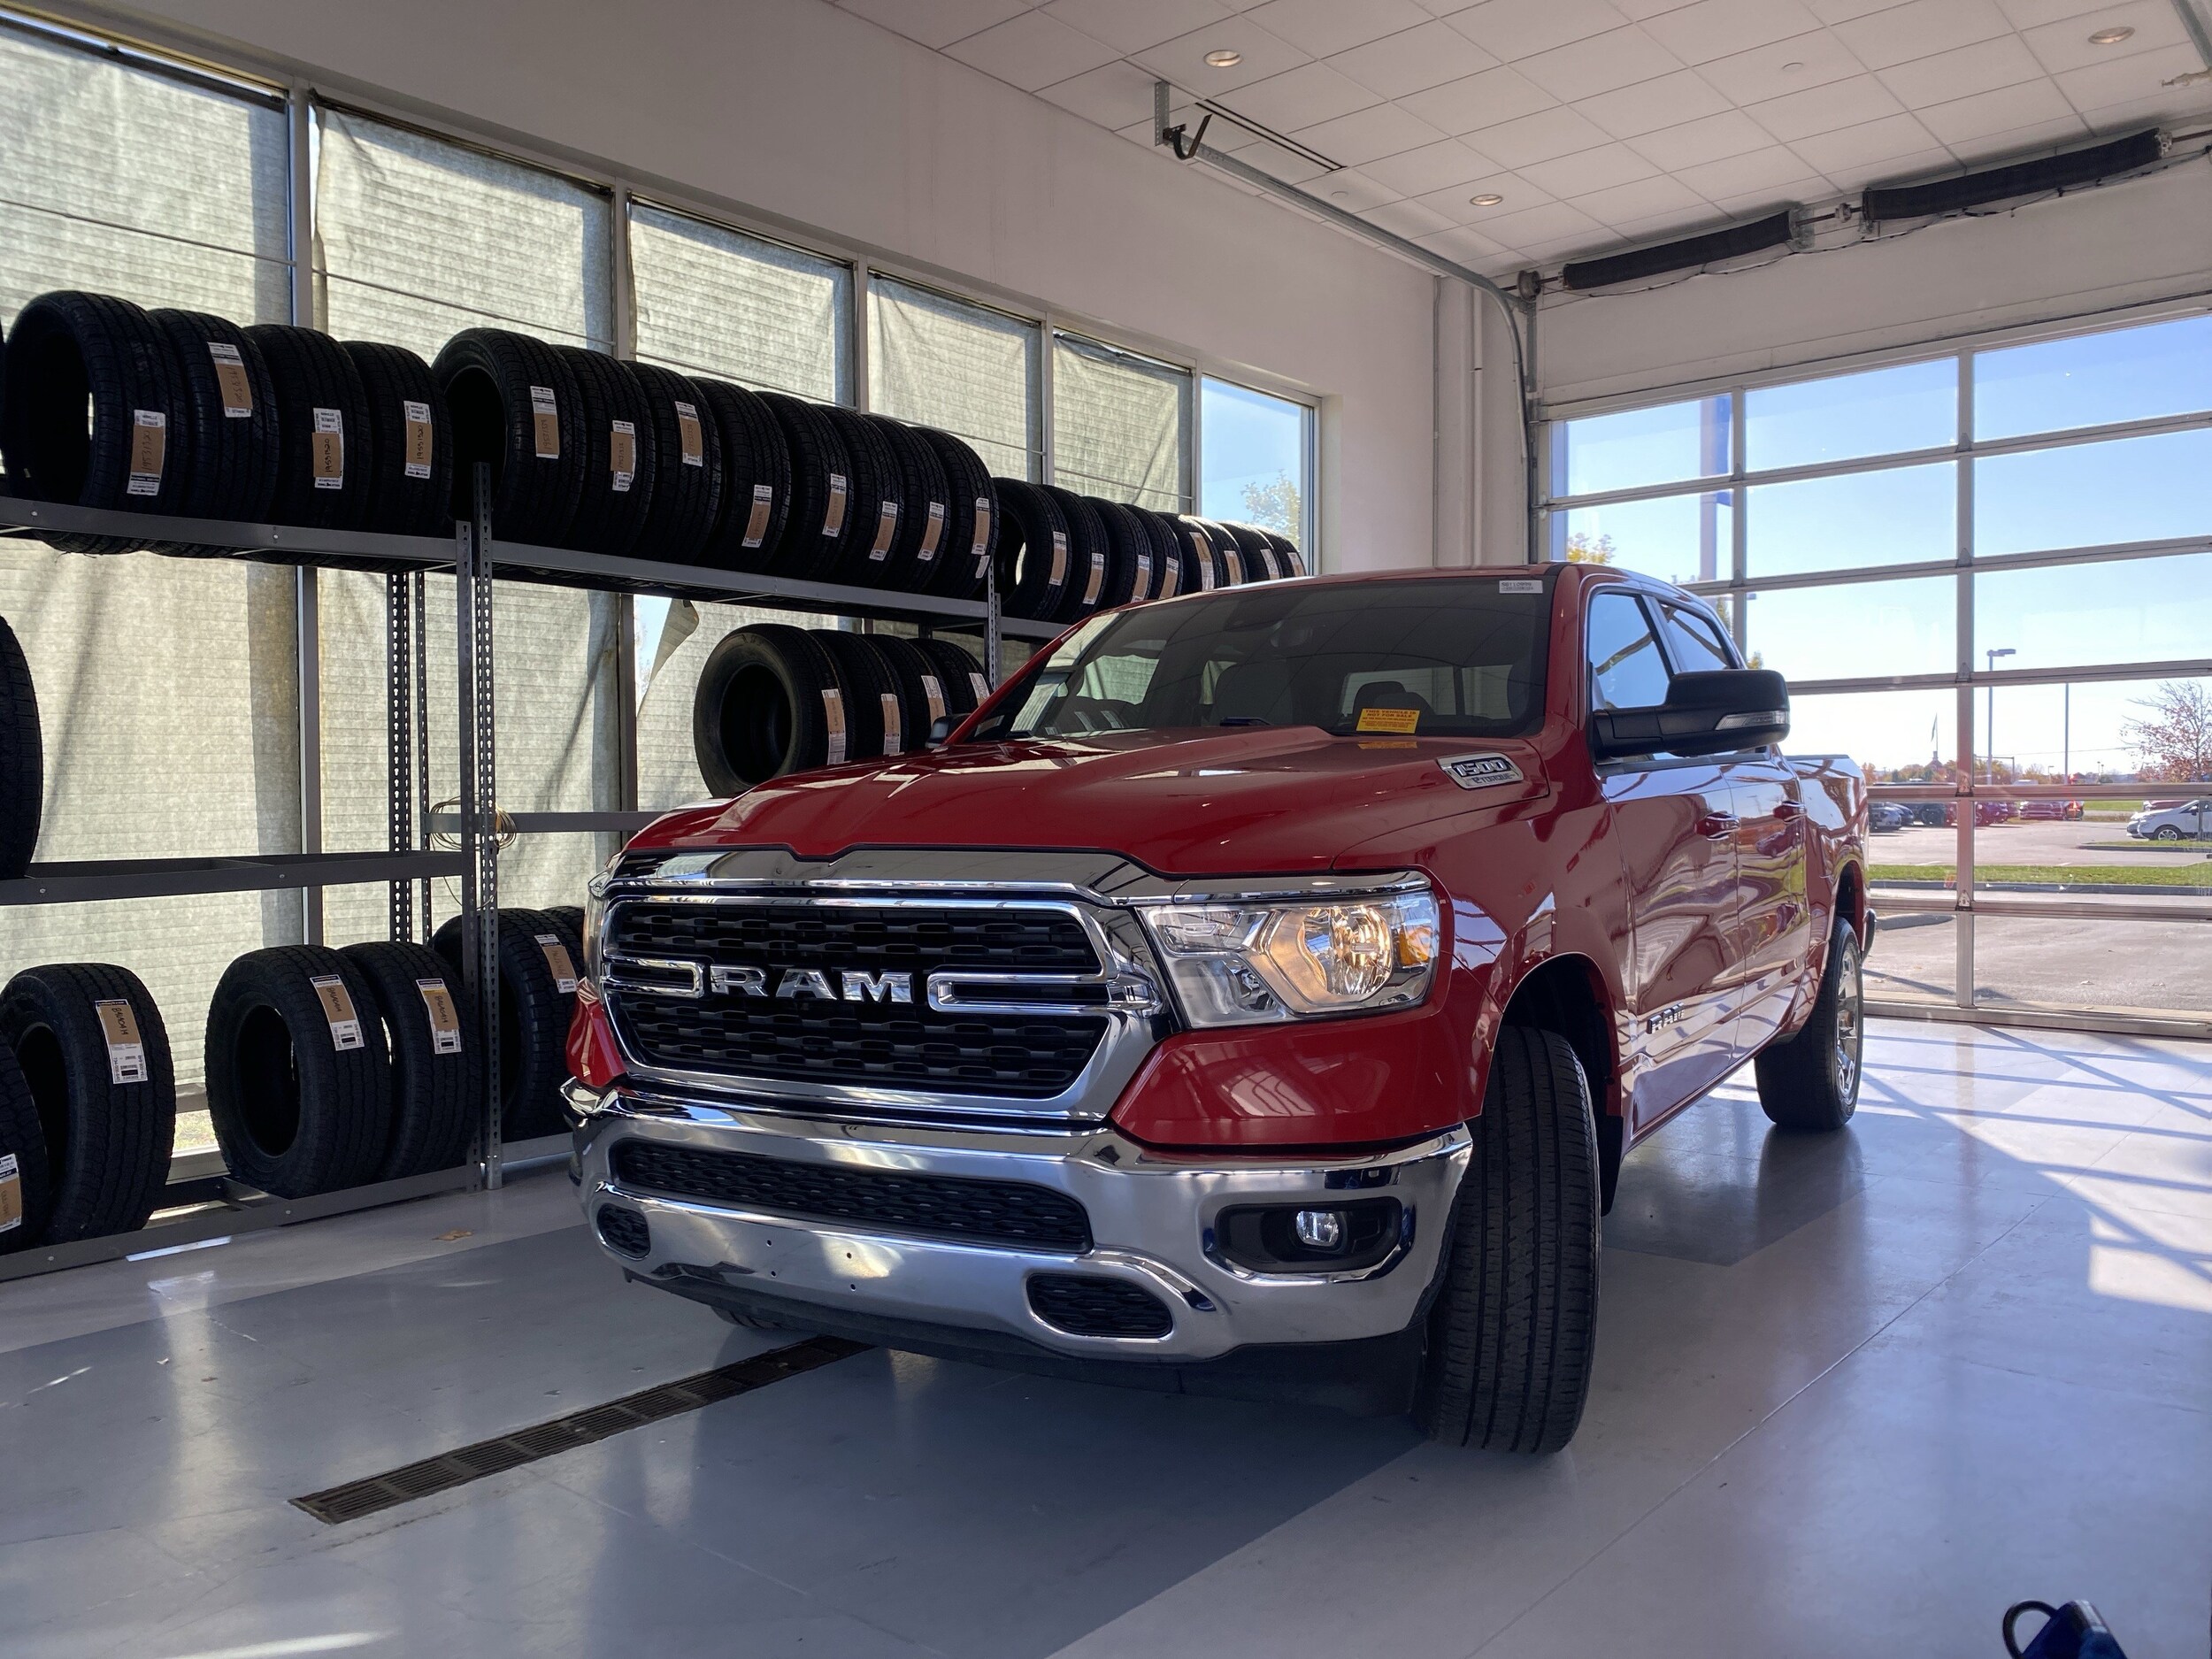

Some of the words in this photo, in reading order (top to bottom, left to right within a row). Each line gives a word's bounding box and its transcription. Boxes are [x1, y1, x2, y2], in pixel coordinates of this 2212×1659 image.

[1453, 759, 1509, 777] 1500
[710, 964, 914, 1004] RAM
[1646, 1002, 1686, 1034] RAM
